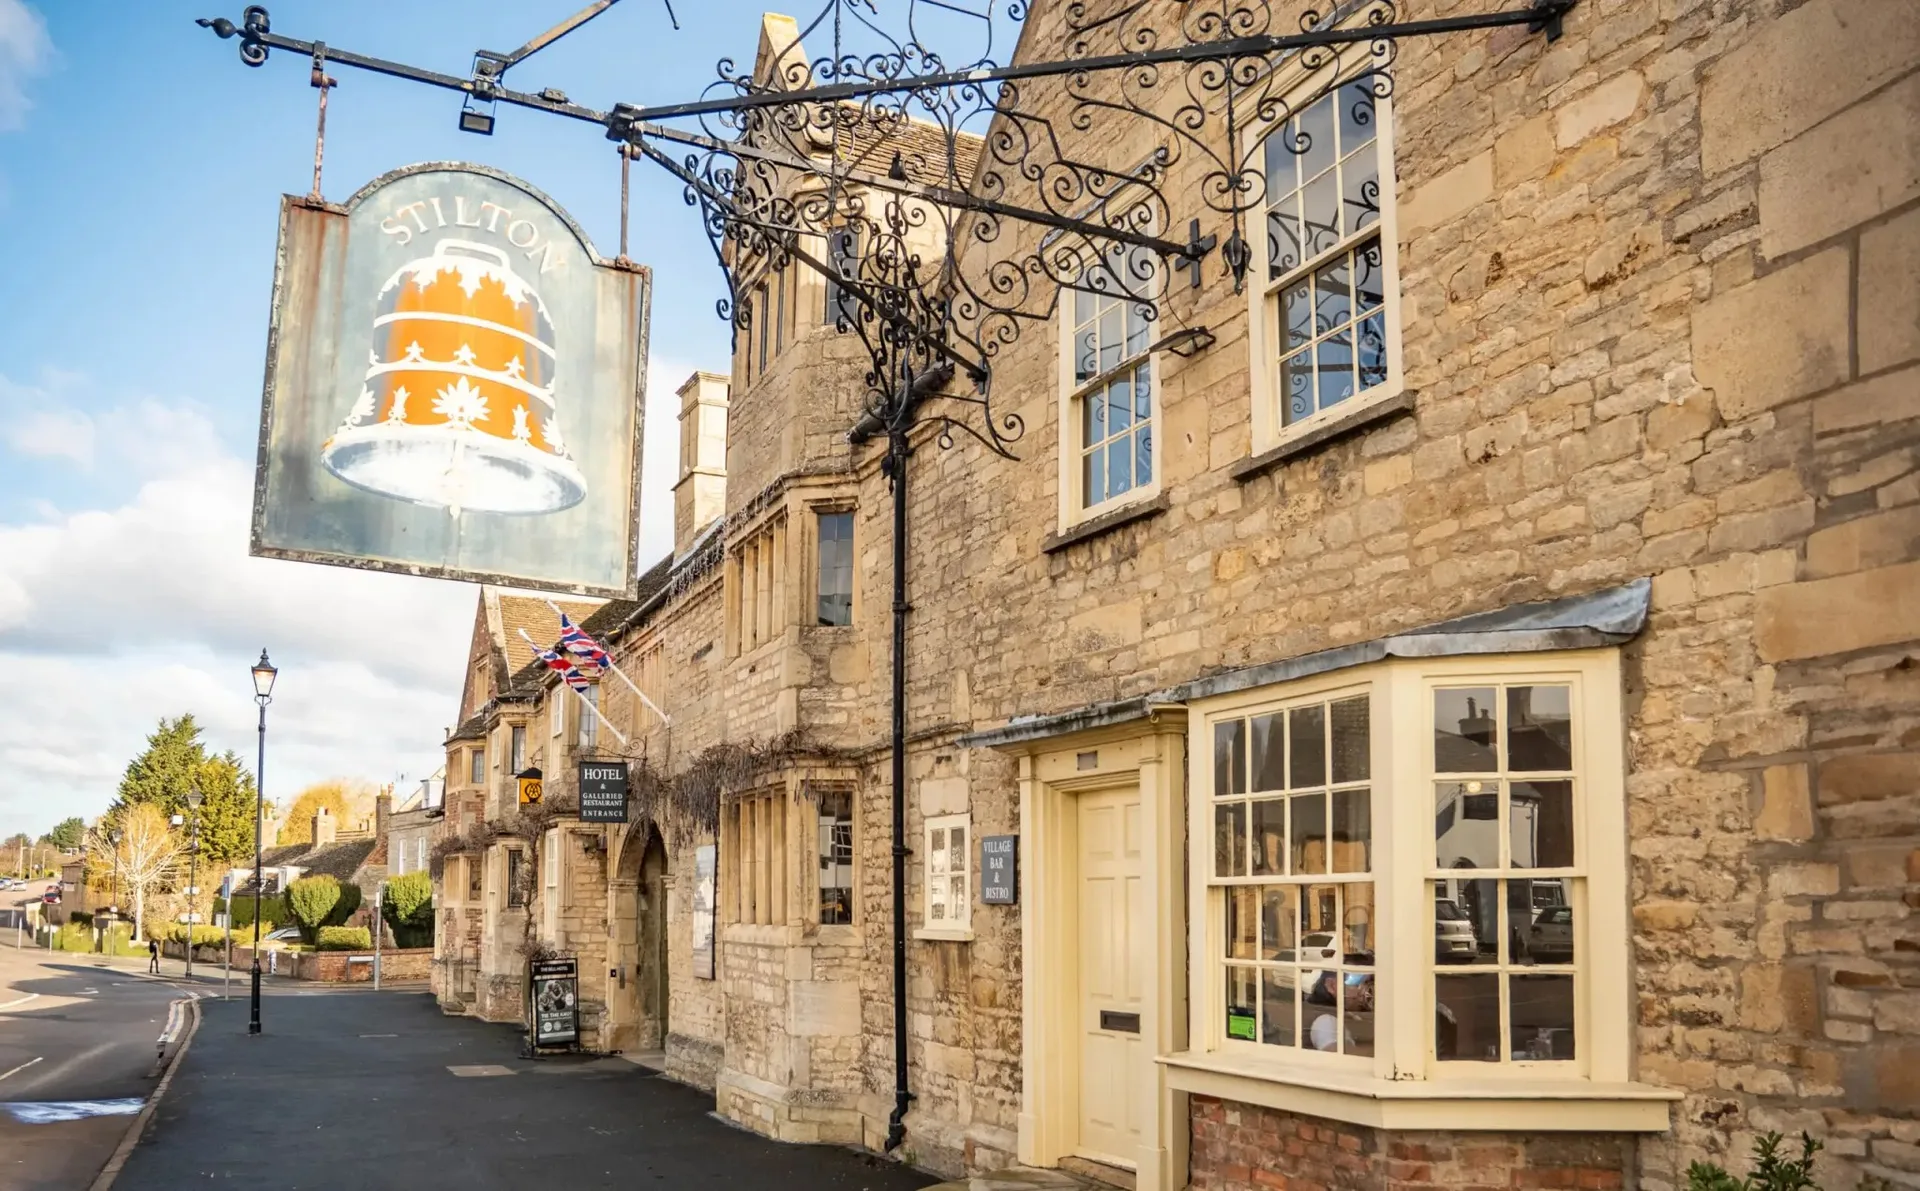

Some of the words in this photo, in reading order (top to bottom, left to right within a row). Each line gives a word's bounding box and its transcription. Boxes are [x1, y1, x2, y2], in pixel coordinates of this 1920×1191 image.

[380, 196, 566, 275] STILTON
[584, 768, 623, 780] HOTEL
[582, 792, 623, 800] GALLERIED
[582, 809, 623, 817] ENTRANCE
[983, 840, 1012, 853] VILLAGE
[989, 857, 1004, 869] BAR
[993, 871, 1000, 883] &
[985, 887, 1009, 899] BISTRO
